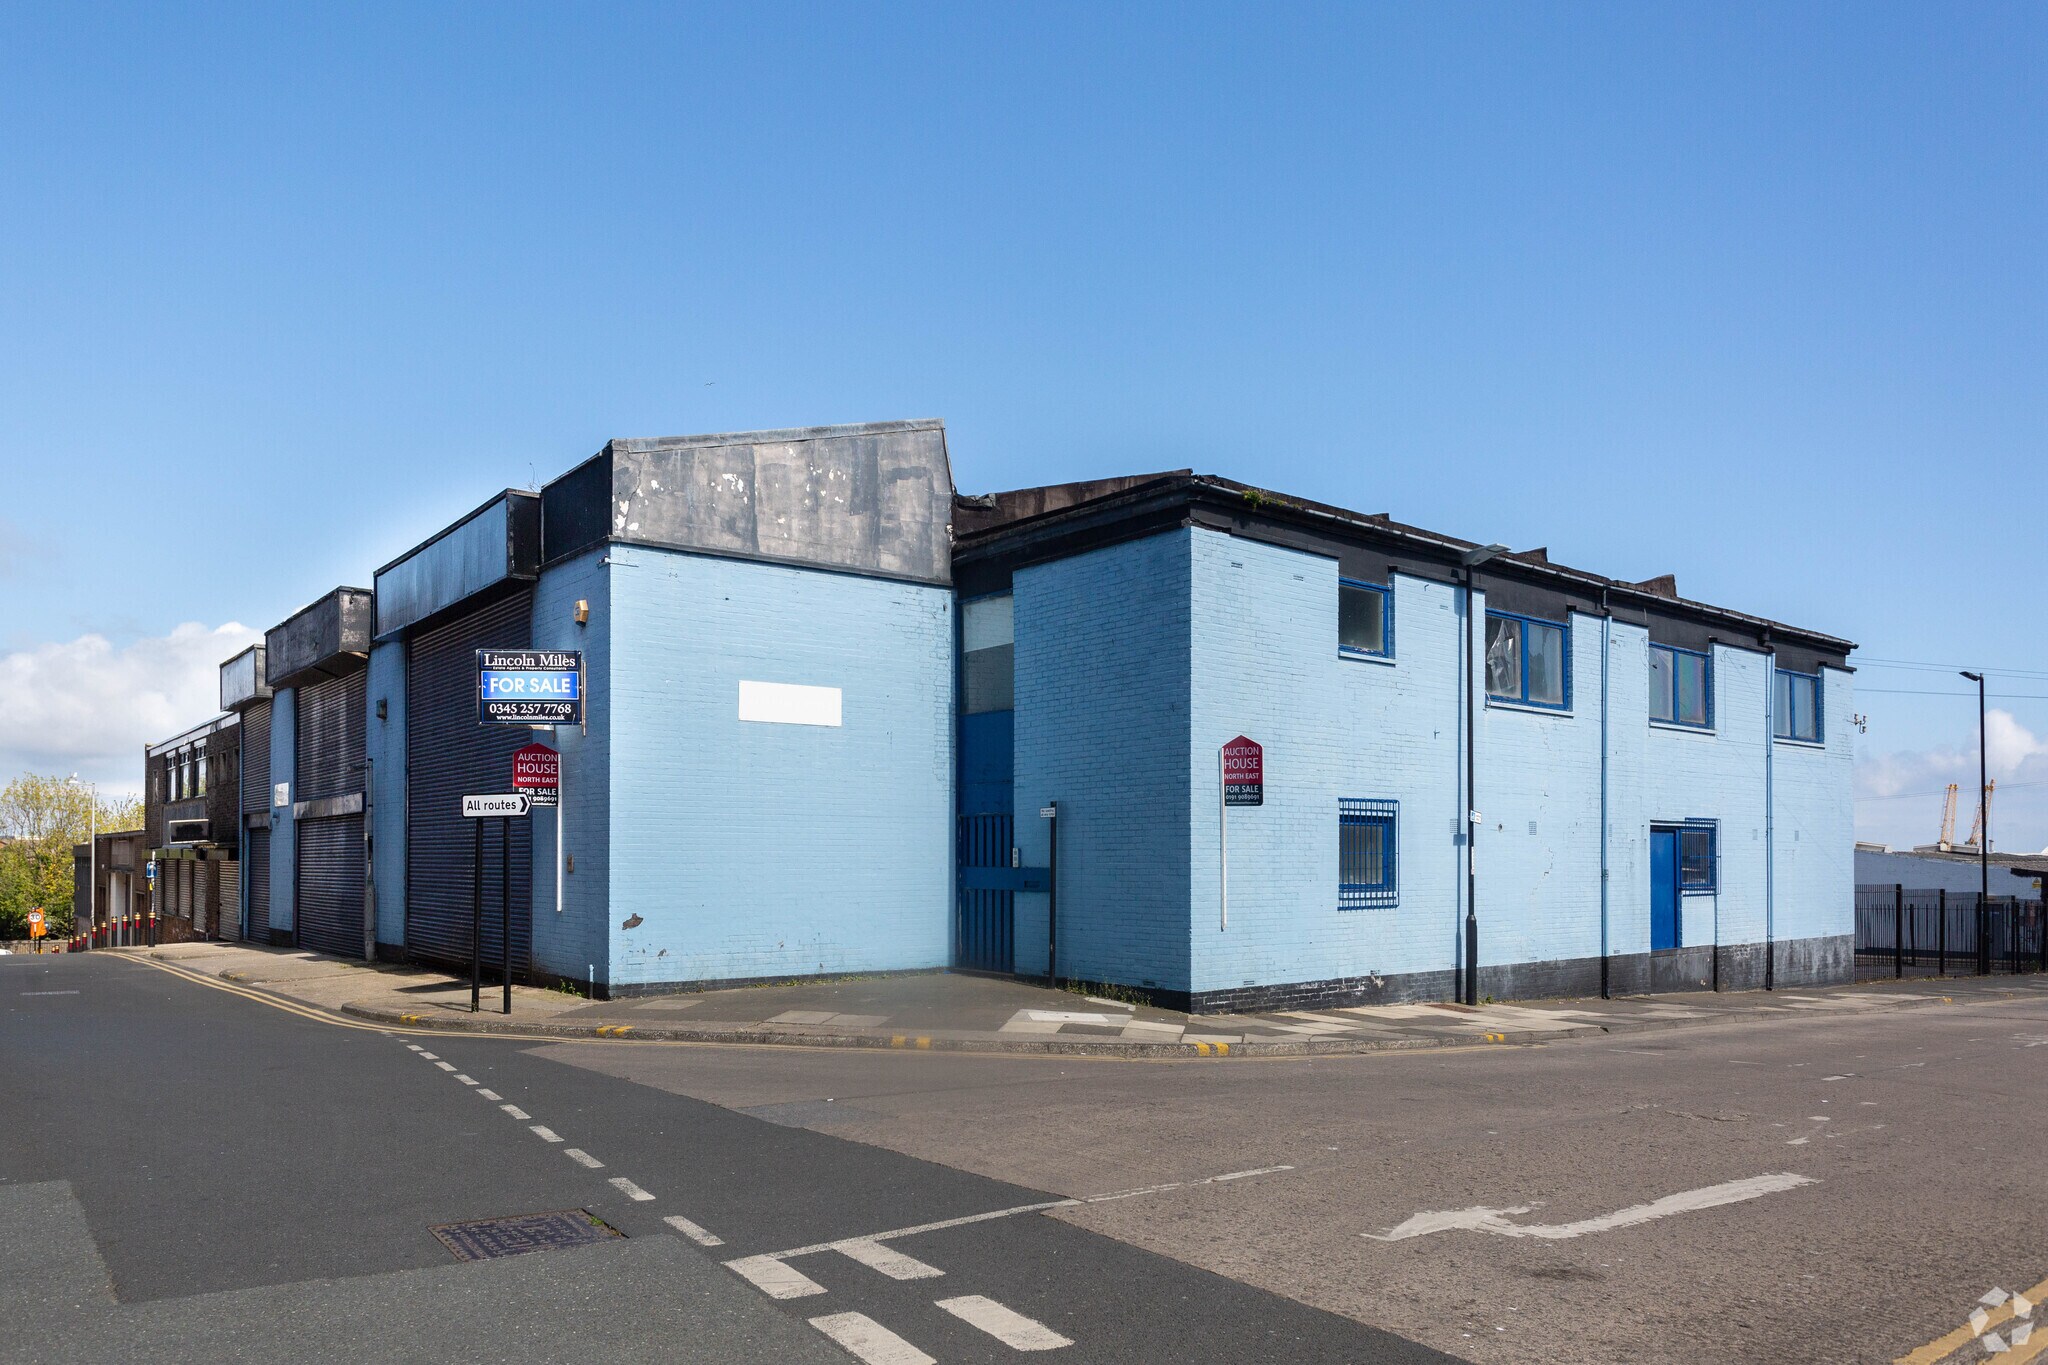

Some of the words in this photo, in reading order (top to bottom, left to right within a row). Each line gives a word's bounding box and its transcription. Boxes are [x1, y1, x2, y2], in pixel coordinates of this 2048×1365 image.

[484, 653, 535, 666] Lincoln
[540, 654, 575, 666] Miles
[490, 678, 524, 693] FOR
[530, 678, 570, 693] SALE
[489, 704, 517, 714] 0345
[520, 704, 541, 714] 257
[543, 704, 572, 714] 7768
[1225, 747, 1259, 756] AUCTION
[518, 753, 557, 762] AUCTION
[517, 763, 557, 774] HOUSE
[1225, 758, 1259, 769] HOUSE
[537, 788, 557, 796] SALE
[467, 800, 481, 811] All
[484, 800, 517, 810] routes
